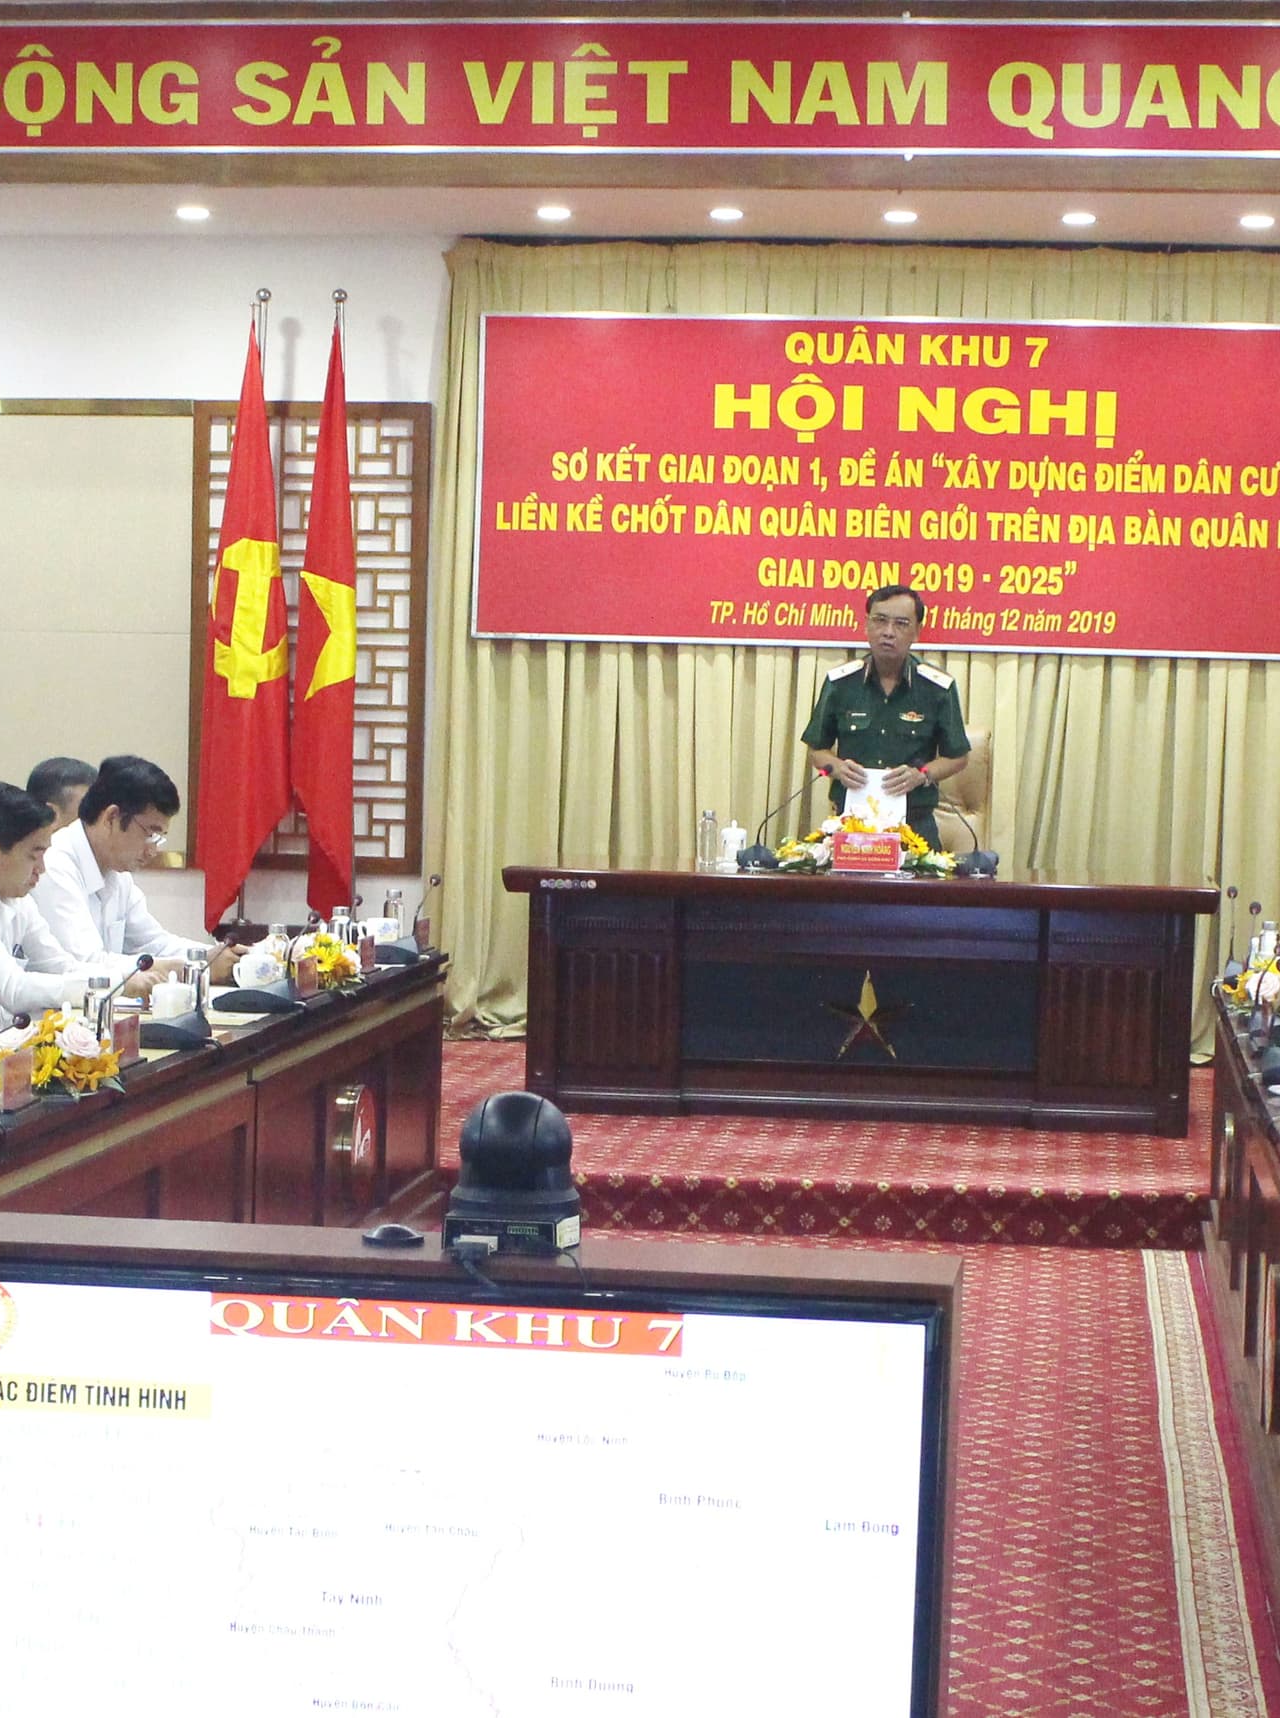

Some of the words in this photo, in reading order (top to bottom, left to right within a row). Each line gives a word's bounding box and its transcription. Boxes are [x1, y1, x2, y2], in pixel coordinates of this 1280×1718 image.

[233, 37, 426, 125] SẢN
[464, 43, 688, 138] VIỆT
[731, 61, 948, 125] NAM
[785, 325, 904, 366] QUÂN
[920, 334, 1010, 368] KHU
[1025, 337, 1048, 368] 7
[714, 373, 864, 443] HỘI
[898, 386, 1117, 448] NGHỊ
[552, 448, 588, 481] SƠ
[596, 443, 651, 482] KẾT
[659, 453, 715, 483] GIAI
[722, 455, 799, 491] ĐOẠN
[810, 457, 827, 492] 1,
[839, 448, 876, 487] ĐỀ
[884, 451, 923, 487] ÁN
[1009, 456, 1086, 497] DỰNG
[1094, 450, 1166, 493] ĐIỂM
[1174, 458, 1232, 494] DÂN
[1240, 462, 1280, 496] CƯ
[496, 493, 558, 531] LIỀN
[566, 494, 603, 532] KỀ
[611, 494, 687, 534] CHỐT
[694, 499, 751, 535] DÂN
[760, 501, 837, 537] QUÂN
[846, 503, 911, 539] BIÊN
[920, 503, 977, 540] GIỚI
[986, 507, 1060, 543] TRÊN
[1068, 514, 1116, 551] ĐỊA
[1124, 509, 1182, 546] BÀN
[1190, 512, 1268, 548] QUÂN
[758, 557, 814, 588] GIAI
[822, 560, 900, 597] ĐOẠN
[910, 563, 973, 593] 2019
[1000, 560, 1077, 595] 2025”
[710, 600, 736, 624] TP.
[743, 600, 770, 626] Hồ
[775, 602, 805, 626] Chí
[810, 604, 858, 632] Minh,
[943, 605, 994, 636] tháng
[1000, 609, 1019, 631] 12
[1022, 607, 1061, 633] năm
[1067, 611, 1116, 635] 2019
[209, 1297, 426, 1340] QUÂN
[454, 1309, 628, 1349] KHU
[647, 1319, 683, 1352] 7
